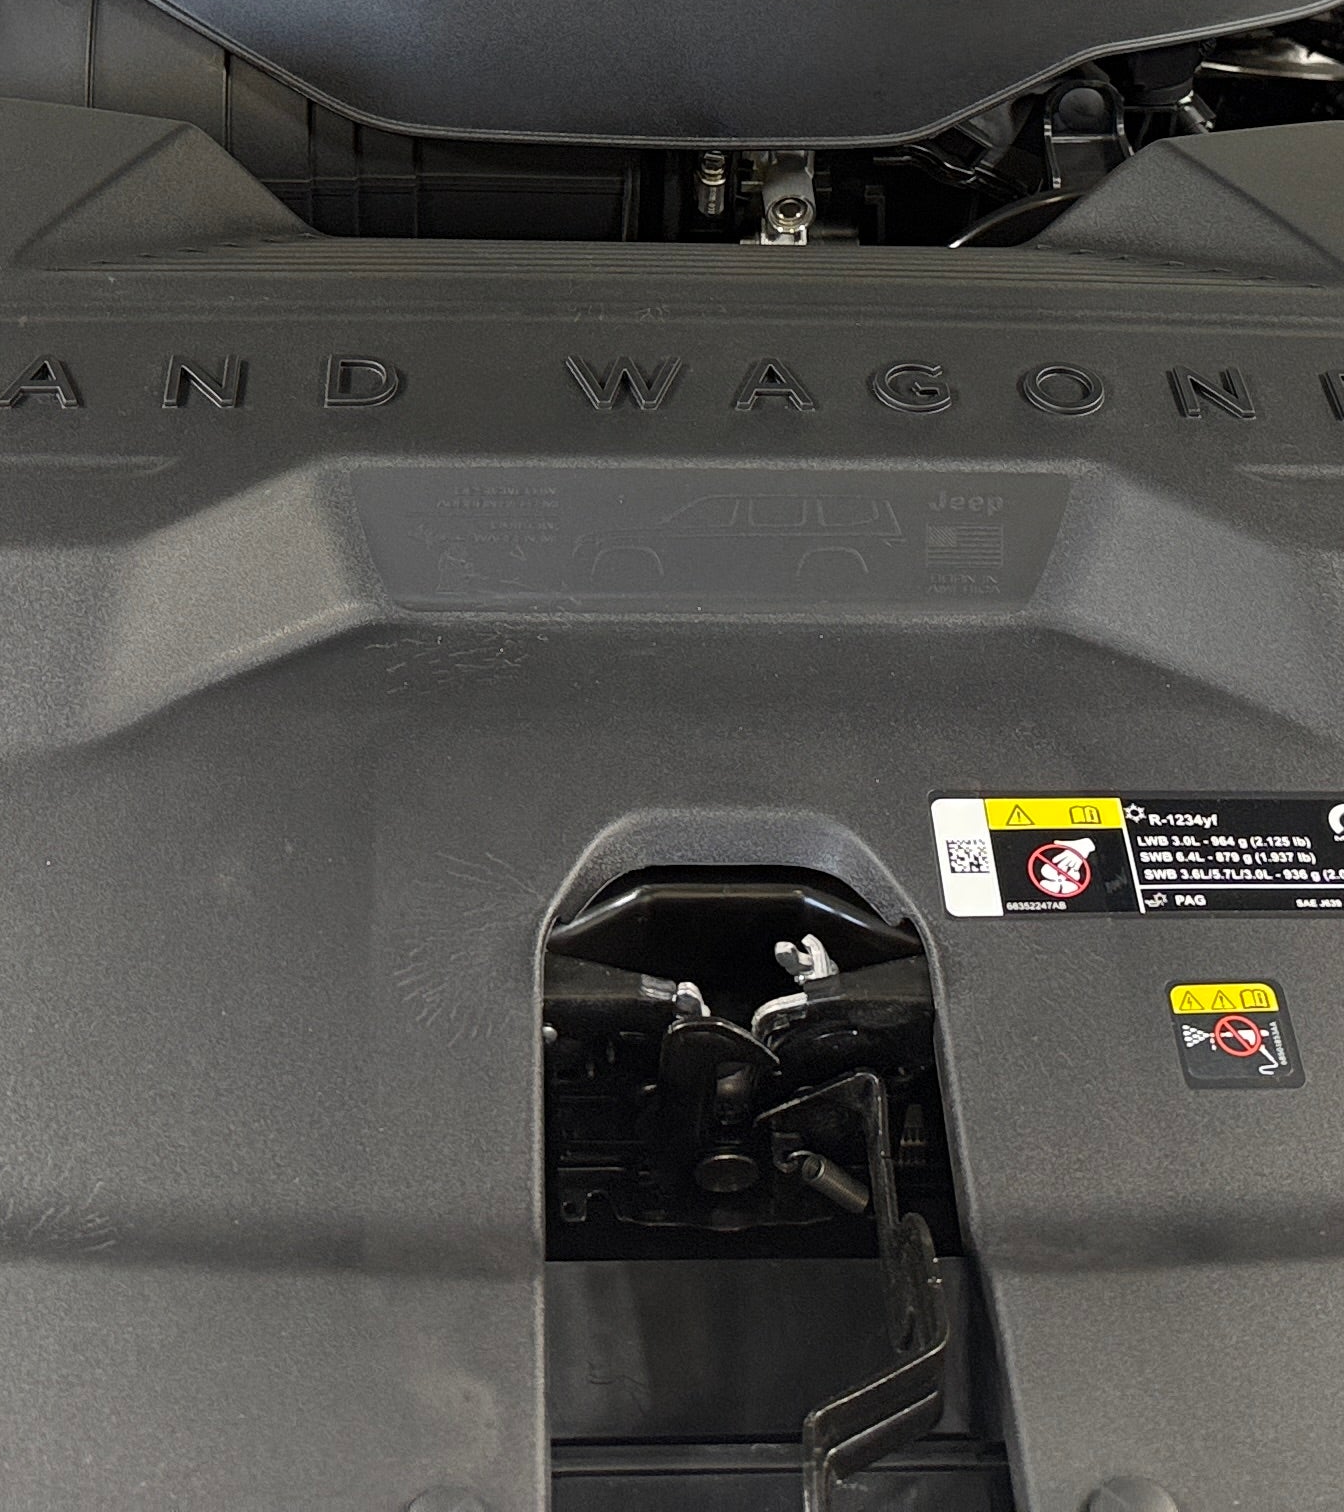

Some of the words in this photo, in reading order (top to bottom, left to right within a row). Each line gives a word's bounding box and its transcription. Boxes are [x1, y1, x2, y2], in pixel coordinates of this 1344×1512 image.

[928, 489, 1004, 517] Jeep
[1147, 813, 1218, 829] R-1234yf
[1136, 836, 1169, 847] LWB
[1172, 836, 1201, 847] 3.0L
[1210, 836, 1235, 847] 964
[1238, 838, 1248, 849] g
[1250, 836, 1291, 849] (2.125
[1292, 836, 1312, 849] lb)
[1139, 851, 1173, 863] SWB
[1175, 851, 1206, 863] 6.4L
[1242, 854, 1253, 865] g
[1255, 852, 1294, 865] (1.937
[1296, 852, 1317, 865] lb)
[1143, 869, 1177, 880] SWB
[1310, 871, 1321, 882] g
[1174, 894, 1207, 907] PAG
[1295, 898, 1318, 908] SAE
